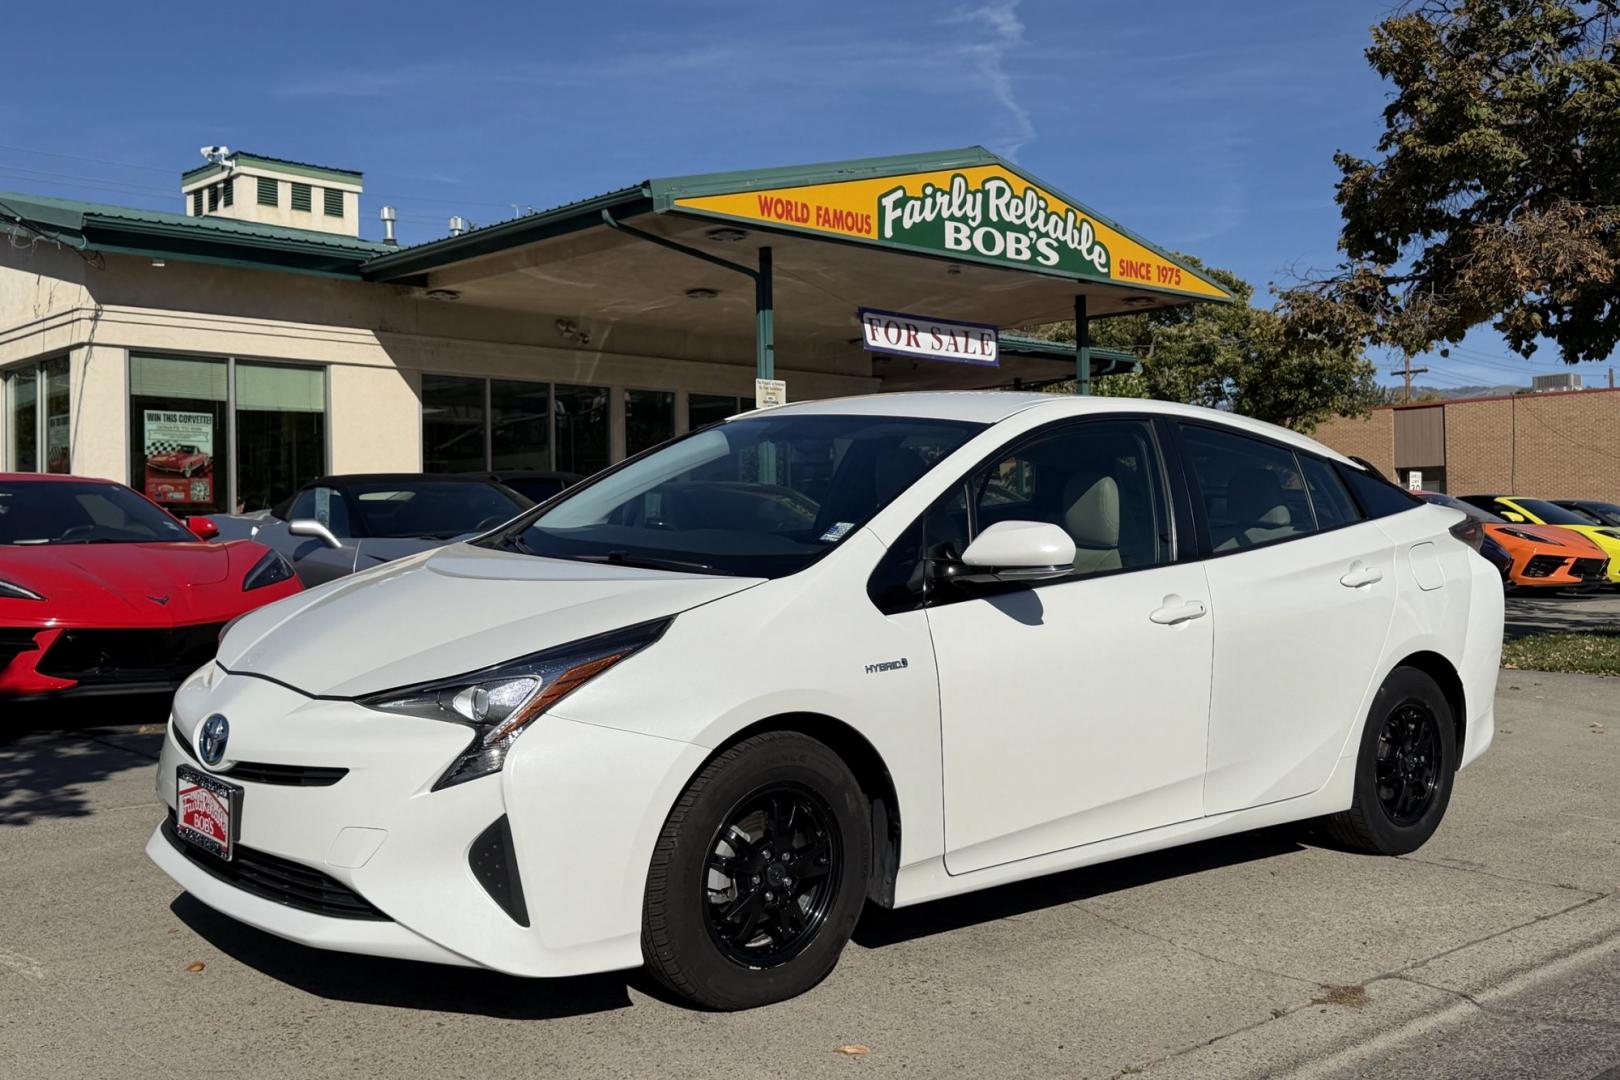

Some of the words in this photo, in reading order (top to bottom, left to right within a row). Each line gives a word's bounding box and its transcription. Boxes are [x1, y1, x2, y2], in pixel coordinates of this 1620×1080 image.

[758, 195, 810, 224] WORLD
[816, 206, 872, 235] FAMOUS
[881, 176, 983, 239] Fairly
[984, 179, 1109, 273] Reliable
[944, 220, 1060, 266] BOB'S
[1119, 259, 1152, 281] SINCE
[1156, 264, 1182, 286] 1975
[867, 317, 921, 348] FOR
[930, 326, 993, 357] SALE
[146, 413, 161, 422] WIN
[163, 413, 178, 423] THIS
[864, 660, 902, 674] HYBRID
